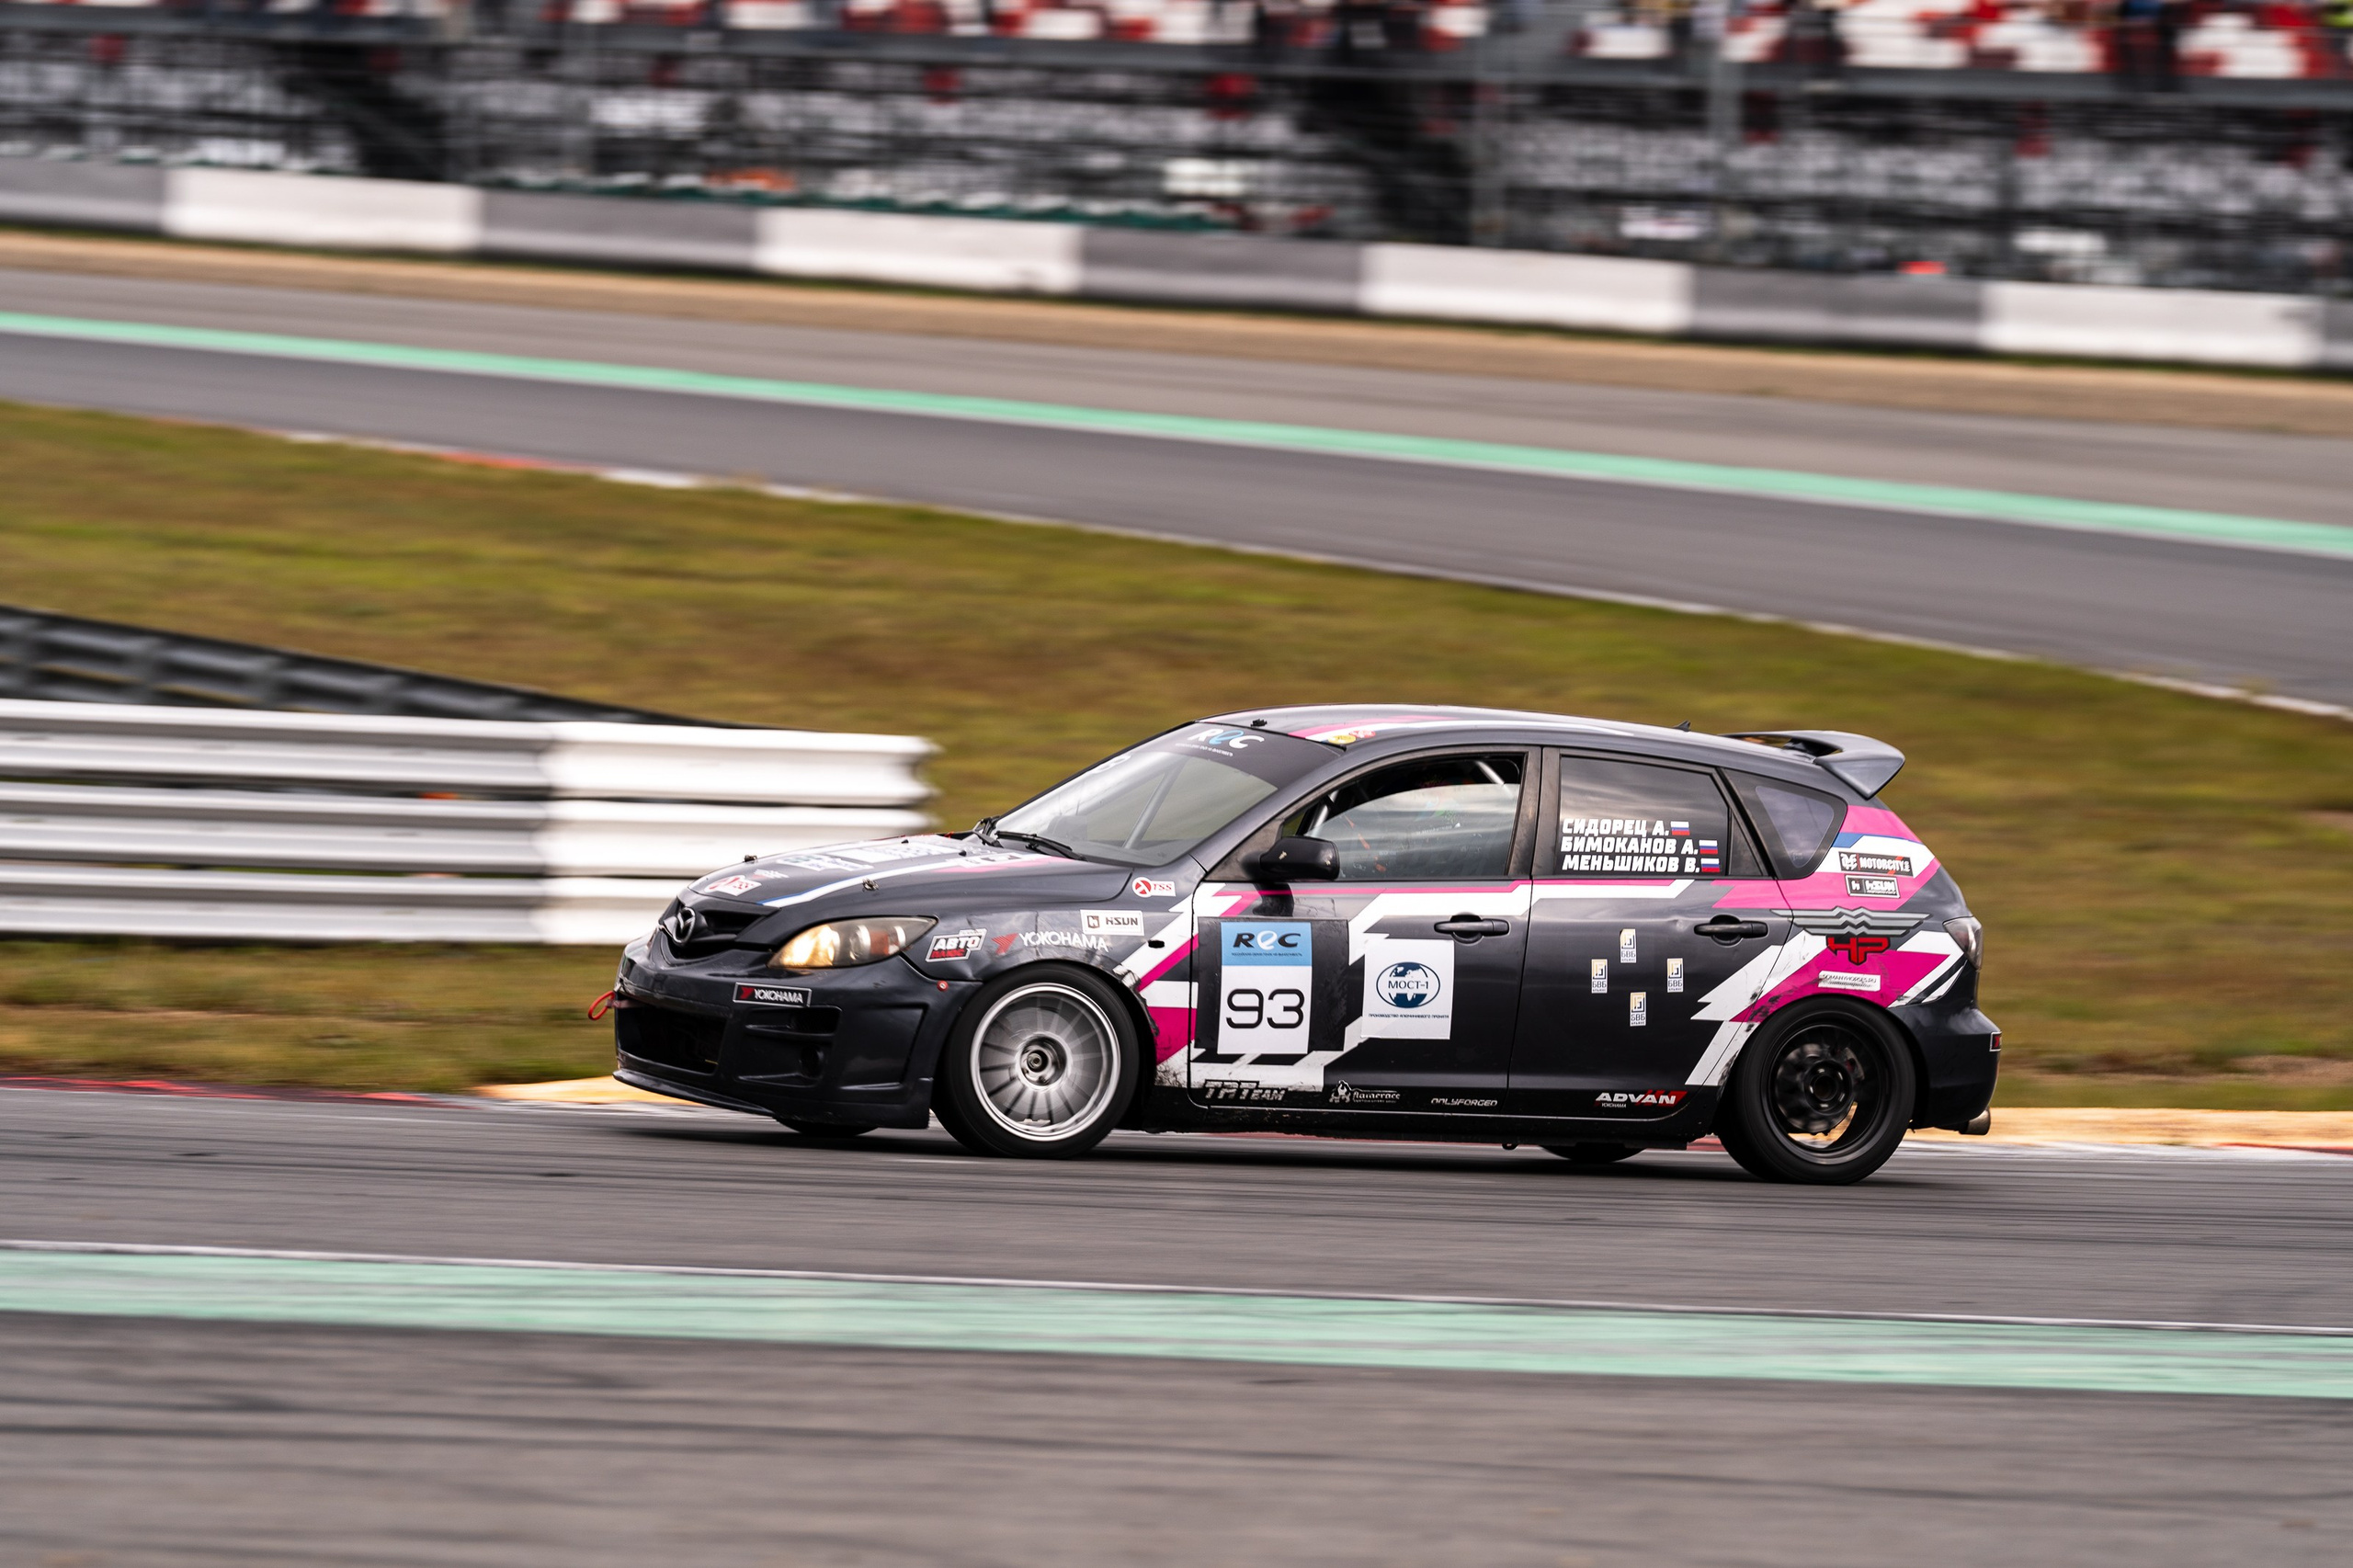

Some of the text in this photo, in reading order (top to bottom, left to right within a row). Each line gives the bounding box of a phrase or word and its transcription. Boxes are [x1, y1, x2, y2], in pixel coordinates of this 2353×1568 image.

[1562, 818, 1670, 837] СИДОРЕЦ А.
[1561, 836, 1699, 855] БИМОКАНОВ А.
[1562, 855, 1700, 873] МЕНЬШИКОВ В.
[1105, 916, 1139, 926] HSUN
[933, 937, 982, 951] АВТО
[1018, 931, 1109, 953] YOKOHAMA
[1388, 980, 1429, 990] МОСТ-1
[754, 988, 803, 1004] YOKOHAMA
[1225, 988, 1305, 1029] 93
[1595, 1092, 1677, 1105] ADVAN
